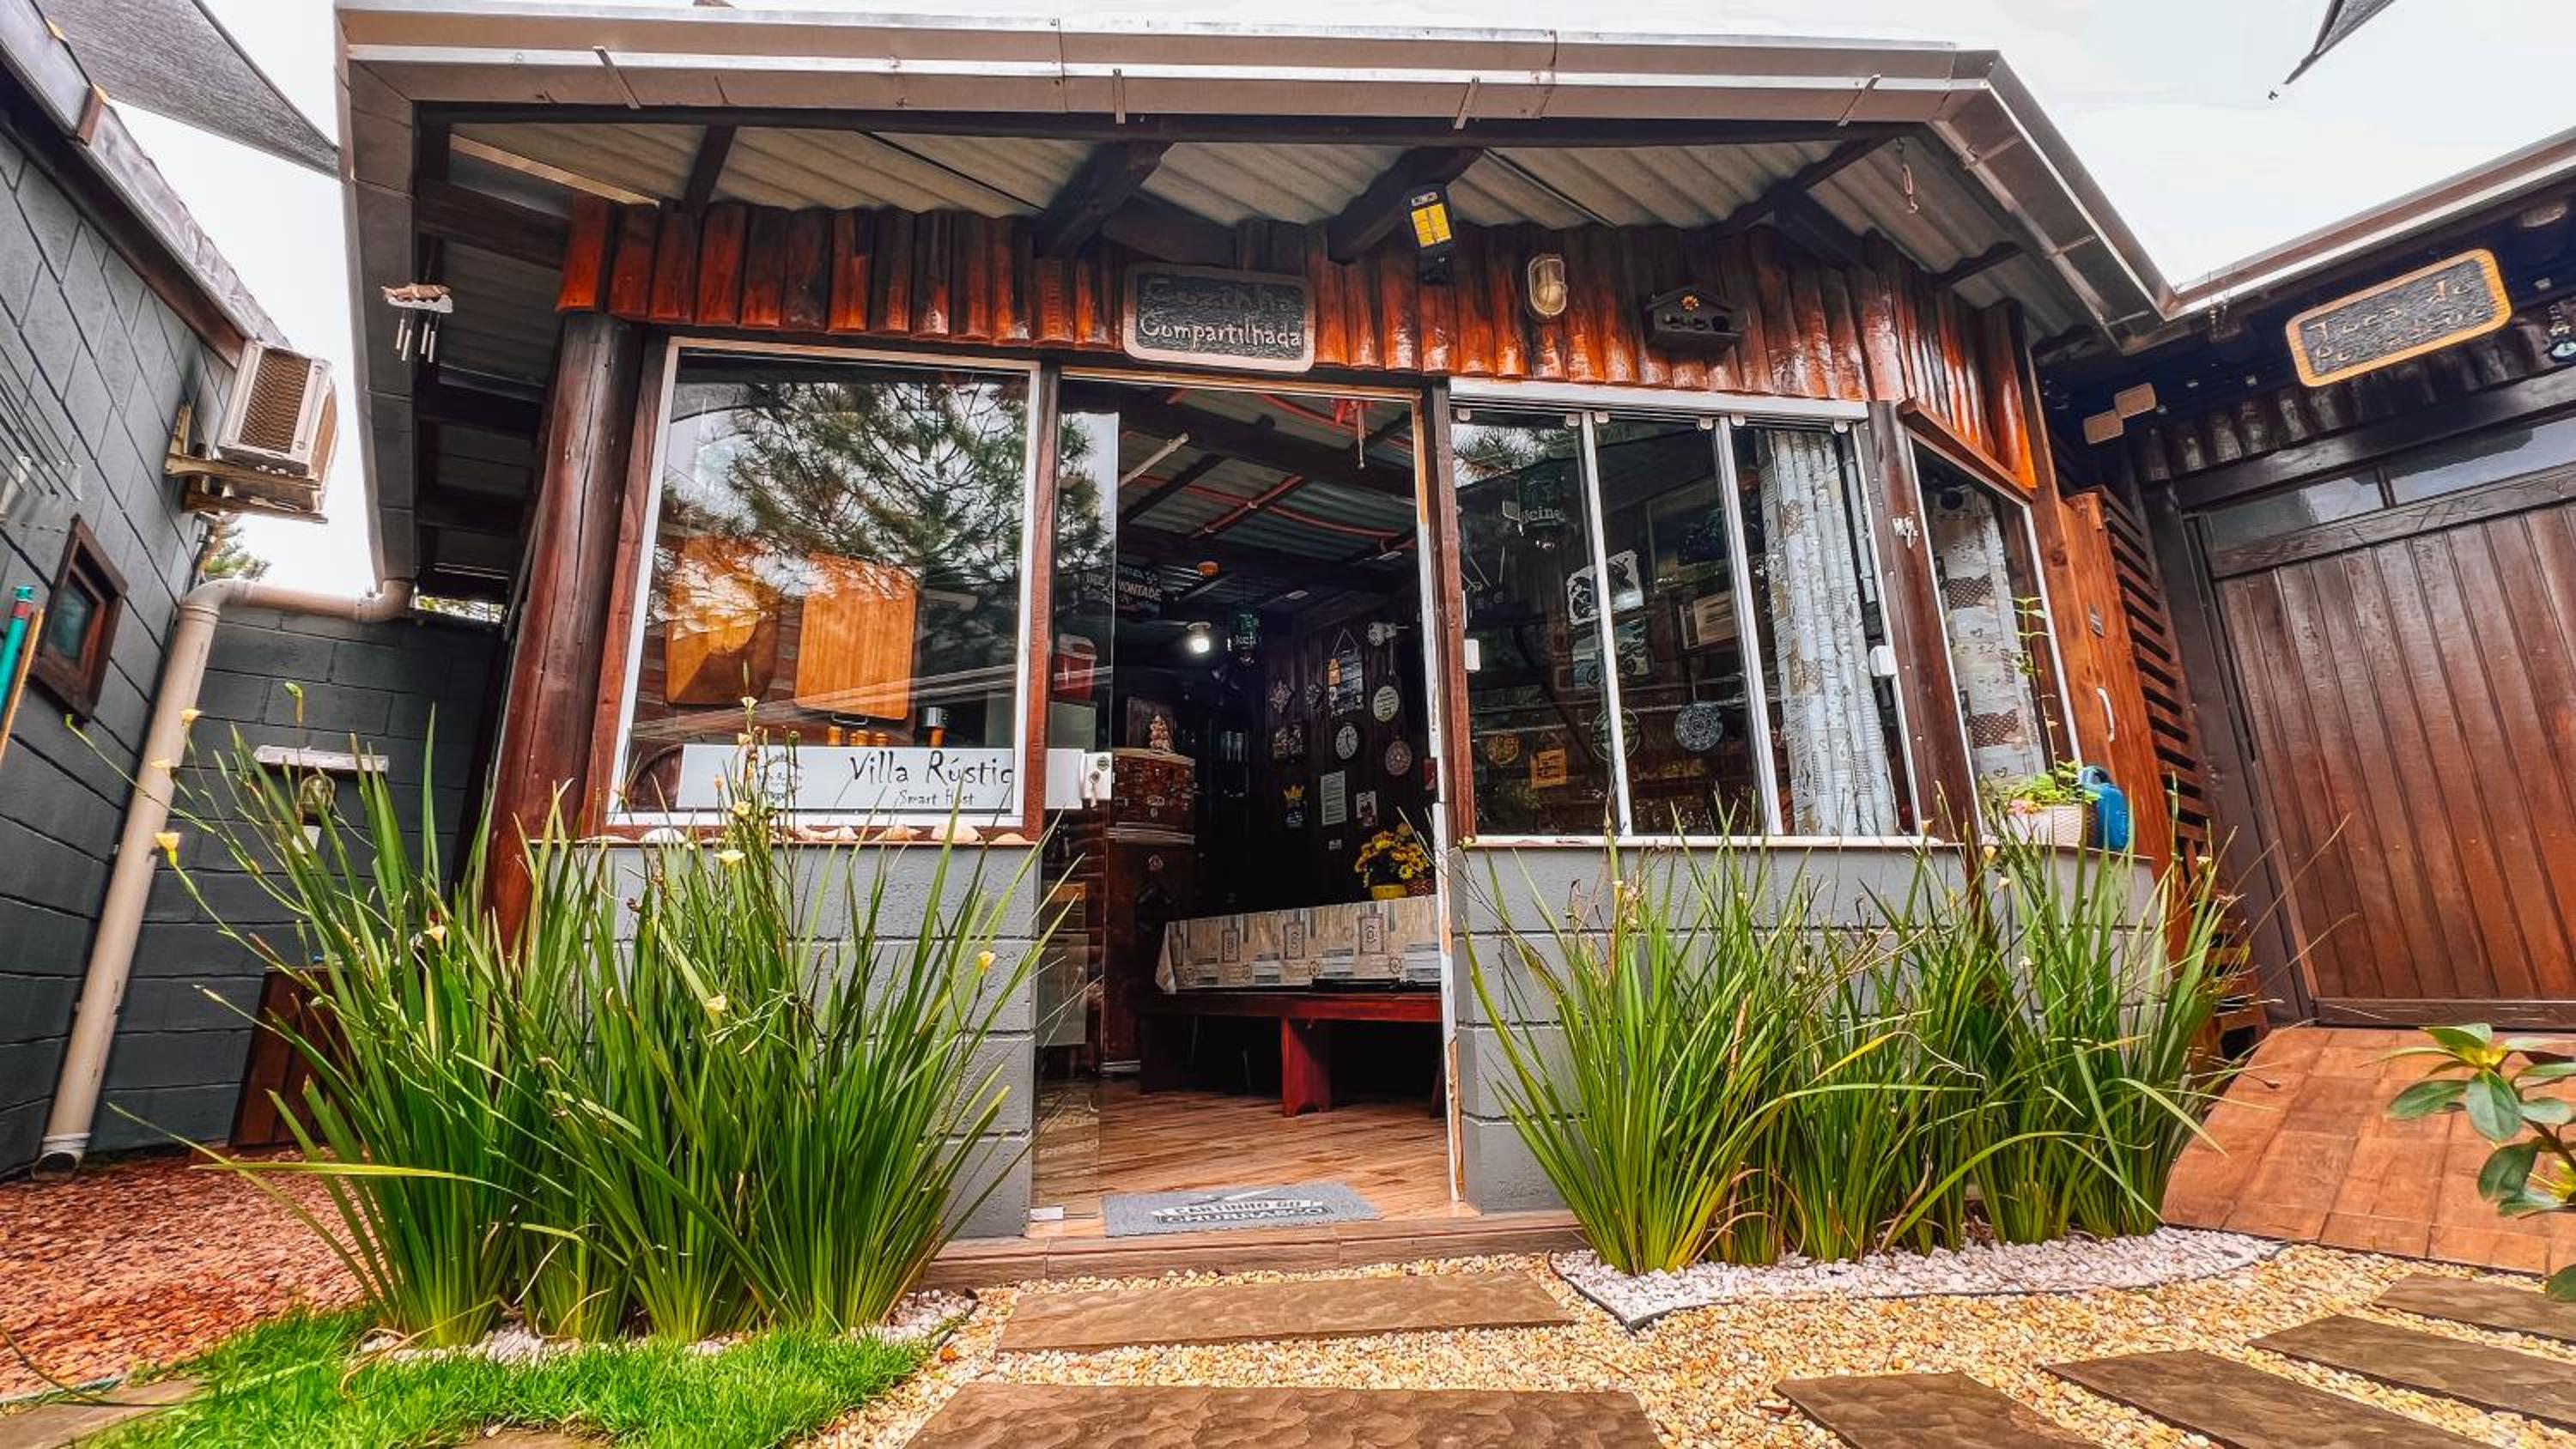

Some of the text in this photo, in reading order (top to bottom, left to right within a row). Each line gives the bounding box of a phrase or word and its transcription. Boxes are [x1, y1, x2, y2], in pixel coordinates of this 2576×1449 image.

[1139, 311, 1303, 349] Compartilhada
[849, 749, 909, 784] Villa
[899, 788, 975, 805] Smart Hst
